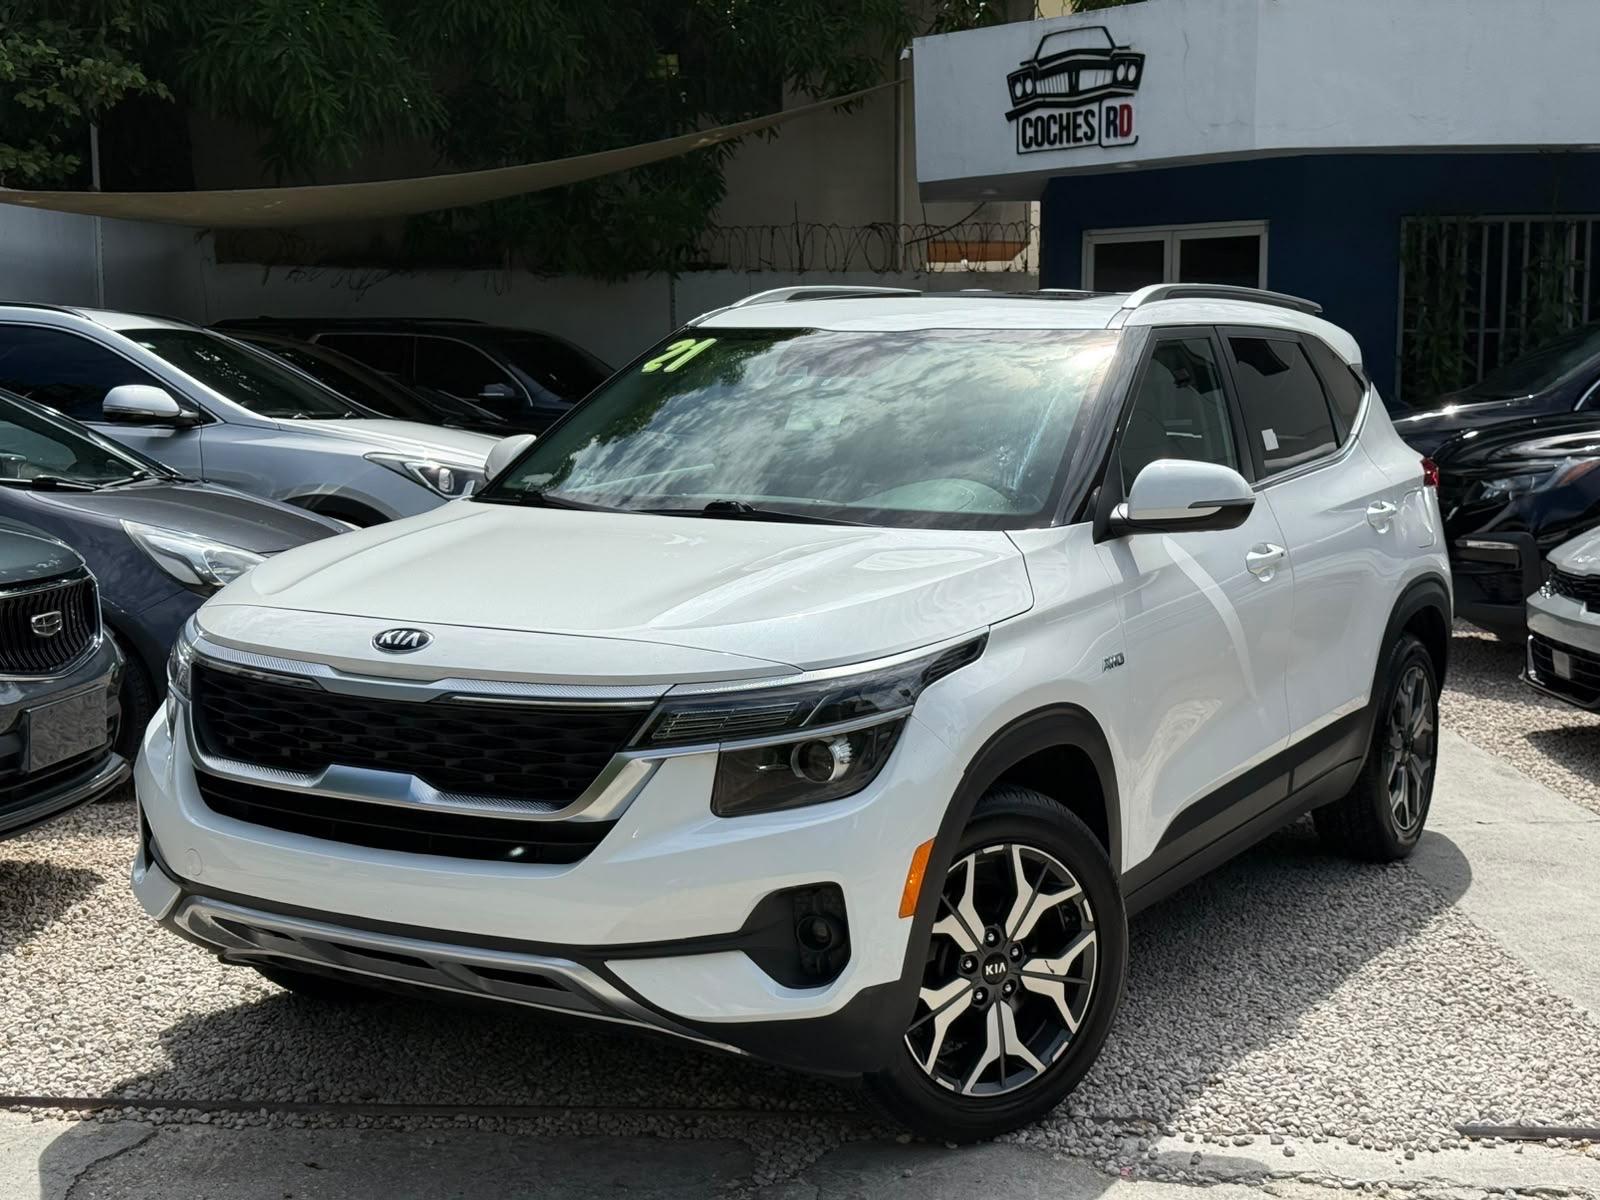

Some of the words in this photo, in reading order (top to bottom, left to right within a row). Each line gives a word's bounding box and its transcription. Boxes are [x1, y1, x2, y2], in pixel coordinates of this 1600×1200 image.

[1021, 108, 1097, 149] COCHES
[1105, 104, 1133, 139] RD
[641, 338, 718, 373] 21
[378, 630, 421, 647] KIA
[985, 962, 1007, 976] KIA
